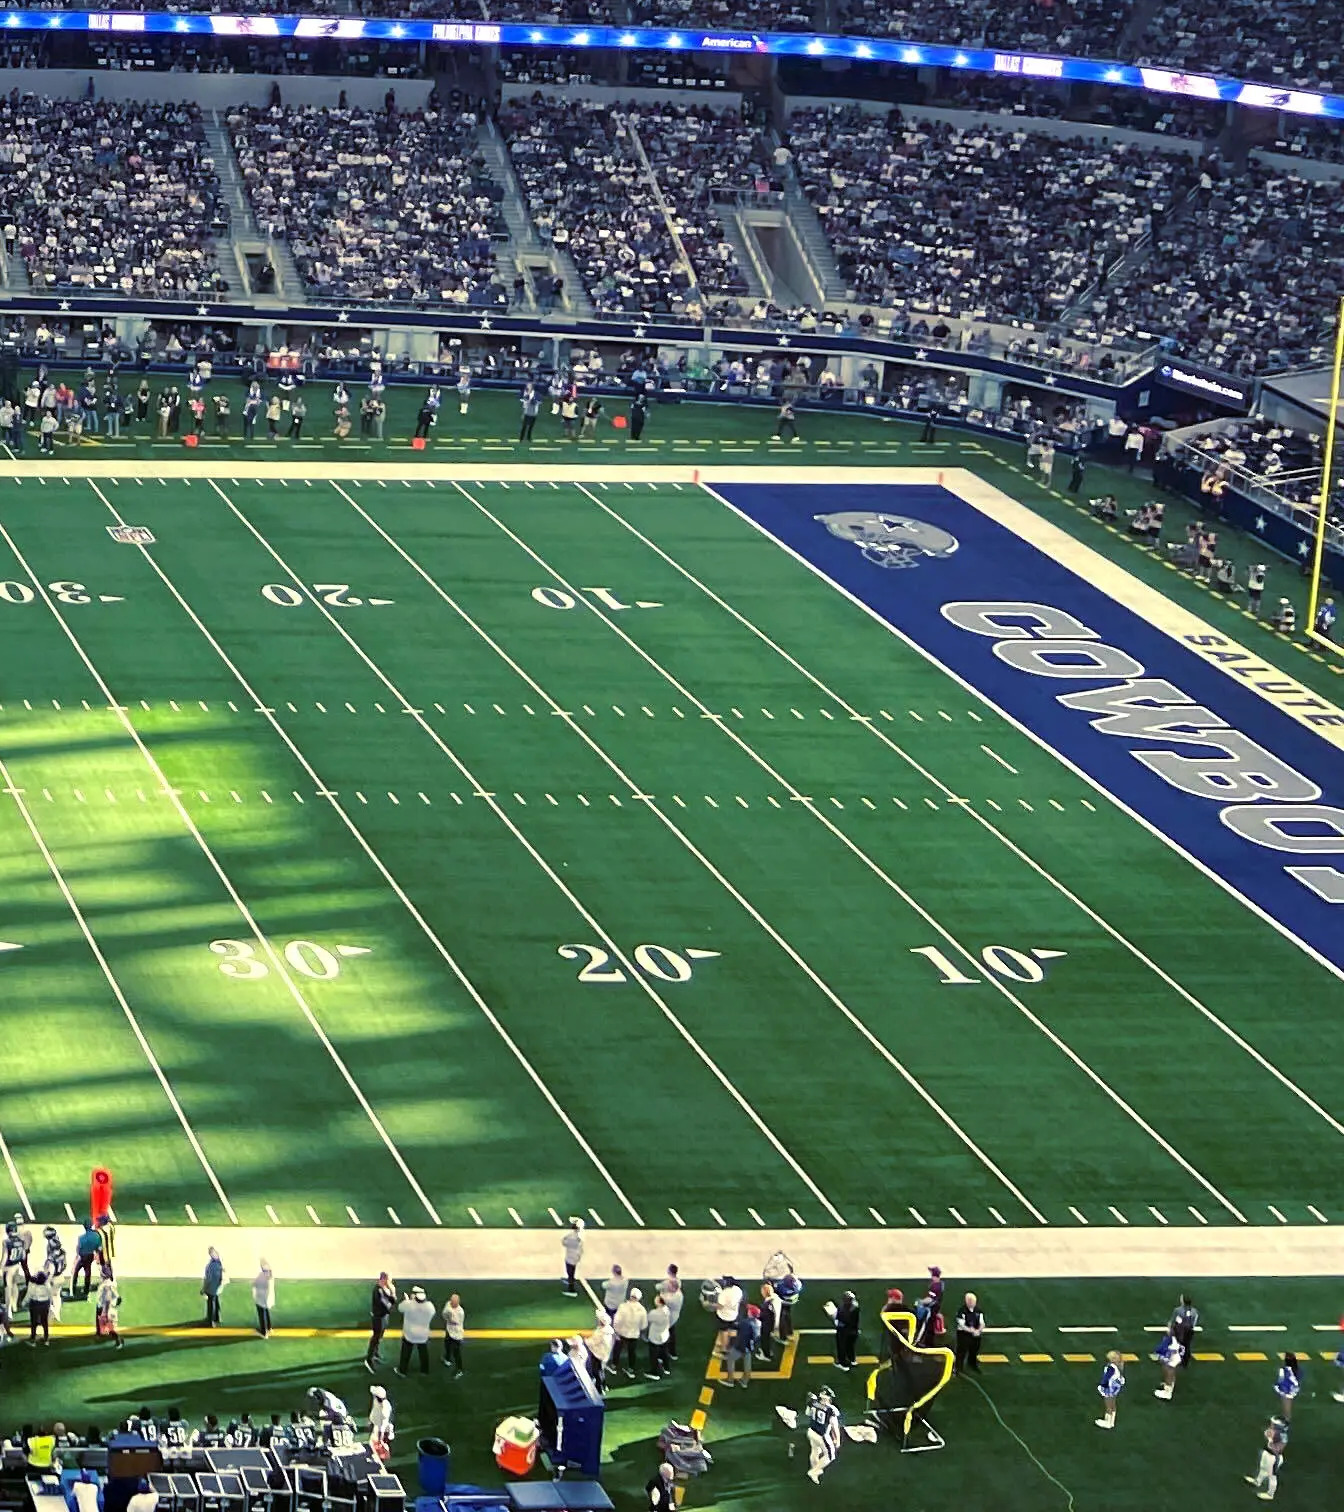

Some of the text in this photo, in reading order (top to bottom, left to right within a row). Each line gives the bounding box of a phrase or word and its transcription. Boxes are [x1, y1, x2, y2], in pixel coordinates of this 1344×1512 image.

[702, 36, 752, 49] American
[260, 582, 364, 609] 20
[530, 585, 634, 611] 10
[1182, 634, 1344, 727] SALUTE
[208, 938, 341, 981] 30
[557, 943, 694, 984] 20
[910, 945, 1047, 985] 10
